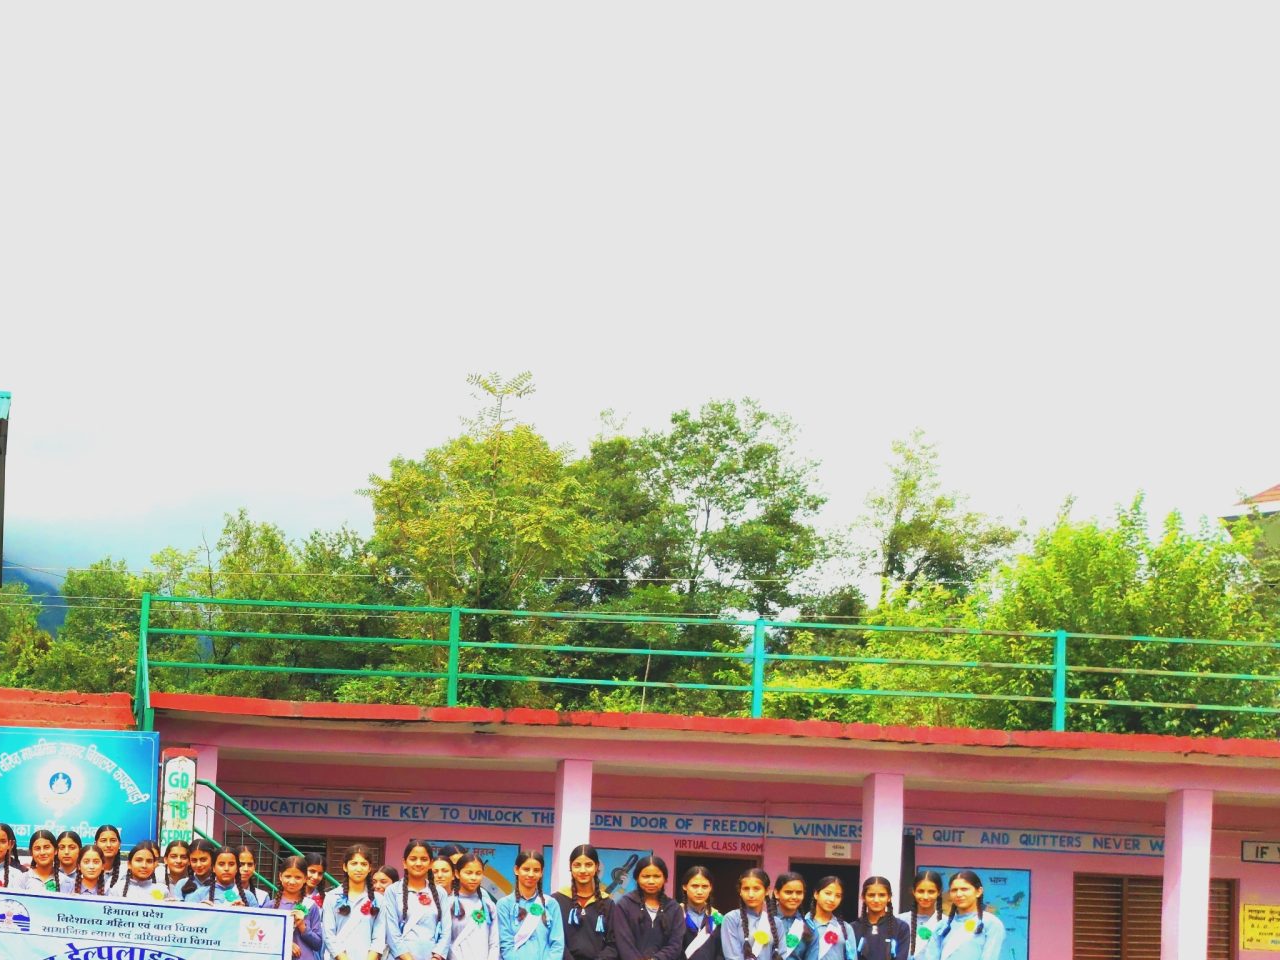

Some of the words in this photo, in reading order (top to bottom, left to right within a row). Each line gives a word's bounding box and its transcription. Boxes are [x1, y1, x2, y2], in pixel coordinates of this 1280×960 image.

[168, 771, 189, 789] GO
[169, 801, 188, 819] TO
[241, 799, 328, 816] EDUCATION
[338, 802, 351, 816] IS
[362, 804, 390, 818] THE
[400, 805, 430, 820] KEY
[440, 807, 460, 820] TO
[469, 808, 523, 823] UNLOCK
[532, 811, 554, 824] THE
[630, 815, 668, 829] DOOR
[675, 817, 693, 831] OF
[703, 818, 774, 835] FREEDOM.
[674, 839, 710, 851] VIRTUAL
[712, 840, 738, 852] CLASS
[740, 842, 764, 853] ROOM
[932, 829, 965, 843] QUIT
[980, 831, 1010, 846] AND
[1019, 832, 1082, 848] QUITTERS
[1092, 835, 1140, 851] NEVER
[1255, 845, 1269, 859] IF
[103, 905, 139, 919] हिमाचल
[142, 908, 164, 920] प्रदेश
[57, 913, 102, 927] निदेशालय
[106, 916, 135, 929] महिला
[175, 922, 208, 934] विकास
[42, 924, 88, 936] सामाजिक
[190, 934, 221, 947] विभाग
